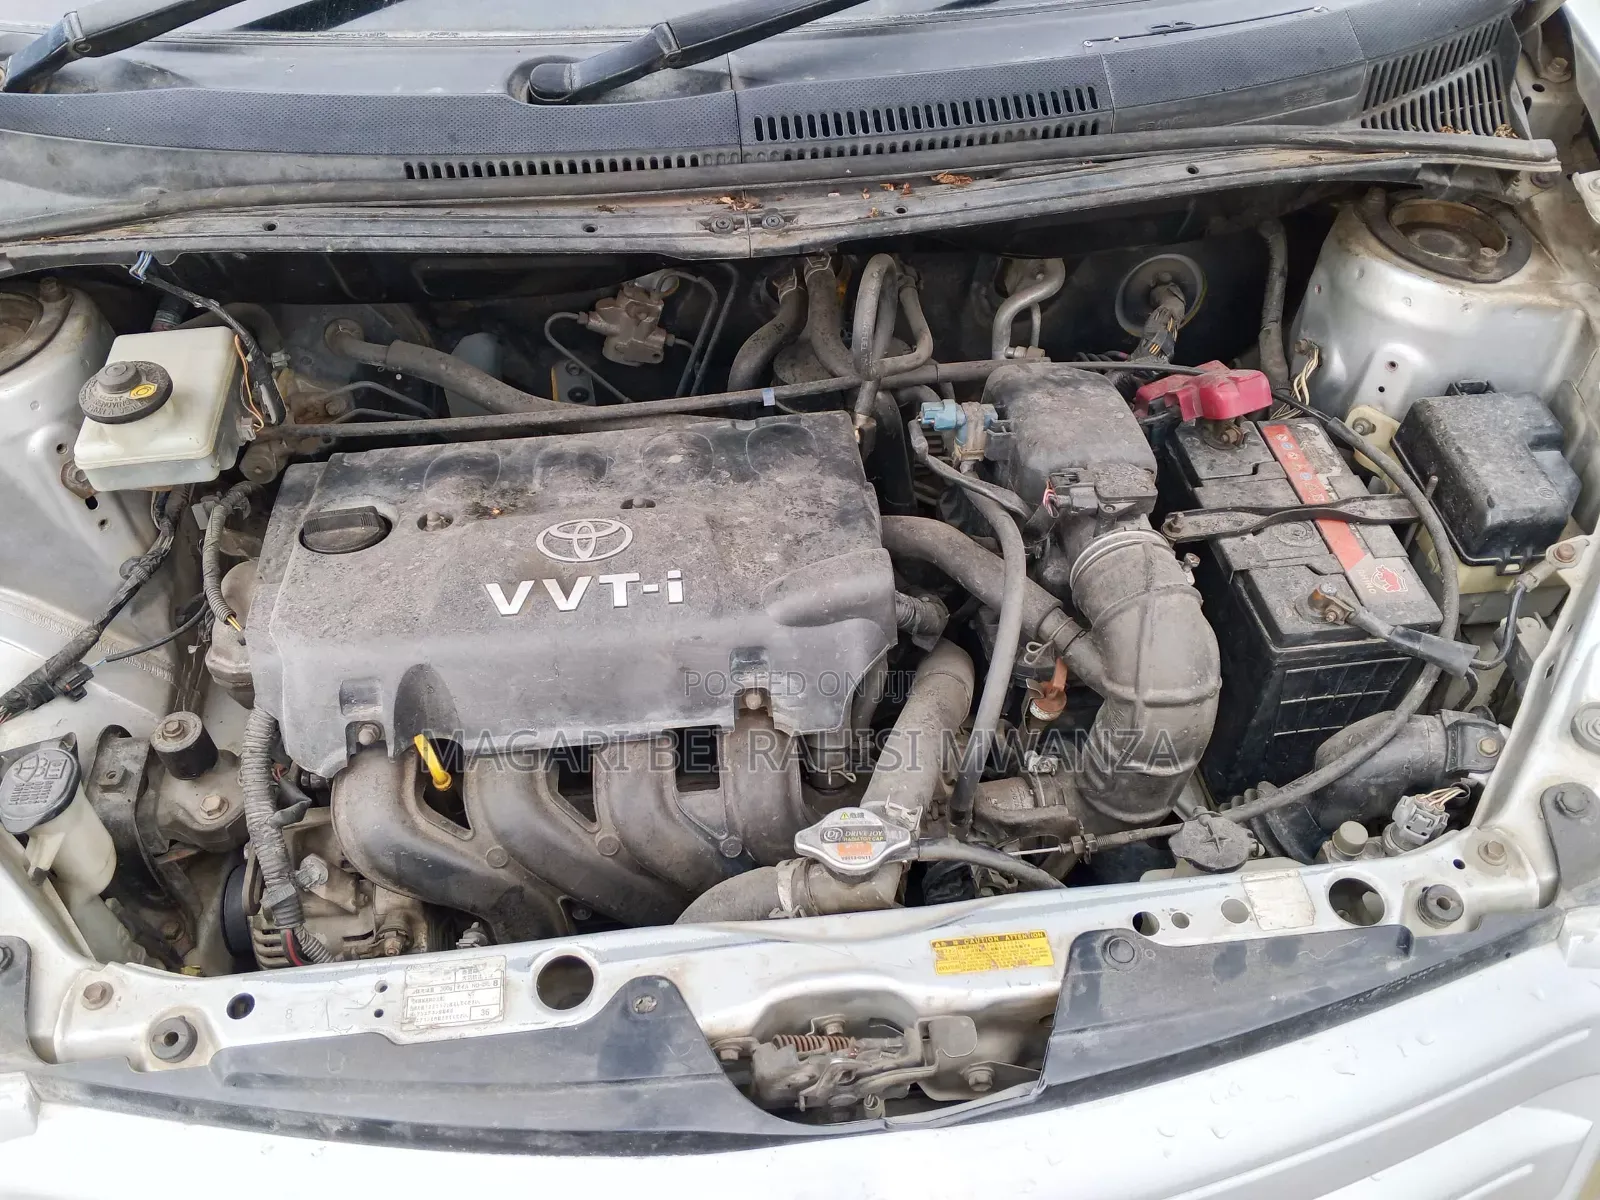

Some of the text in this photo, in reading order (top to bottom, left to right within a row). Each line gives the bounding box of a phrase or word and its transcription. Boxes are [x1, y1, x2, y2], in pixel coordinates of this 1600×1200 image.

[485, 569, 684, 616] VVT-i
[964, 936, 1000, 945] CAUTION
[1005, 931, 1044, 941] ATTENTION
